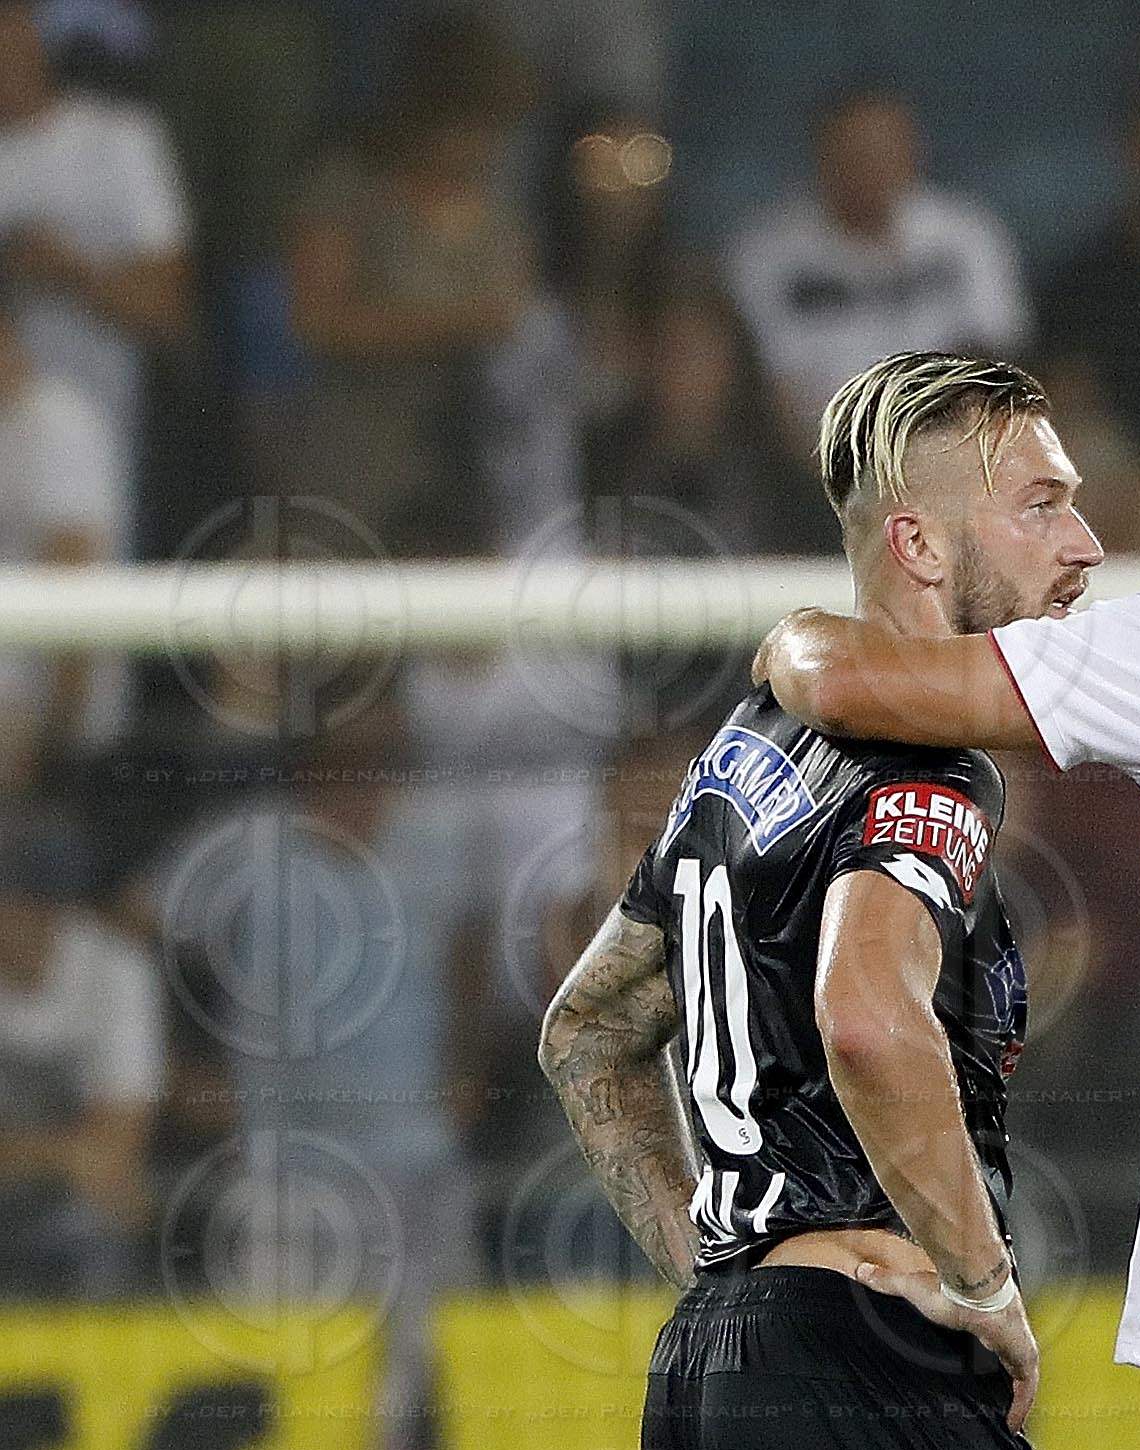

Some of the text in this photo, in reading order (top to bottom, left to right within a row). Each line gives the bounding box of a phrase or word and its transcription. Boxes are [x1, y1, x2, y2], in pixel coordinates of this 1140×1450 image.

[871, 818, 976, 891] ZEITUNG
[875, 791, 988, 863] KLEINE
[673, 858, 762, 1156] 10
